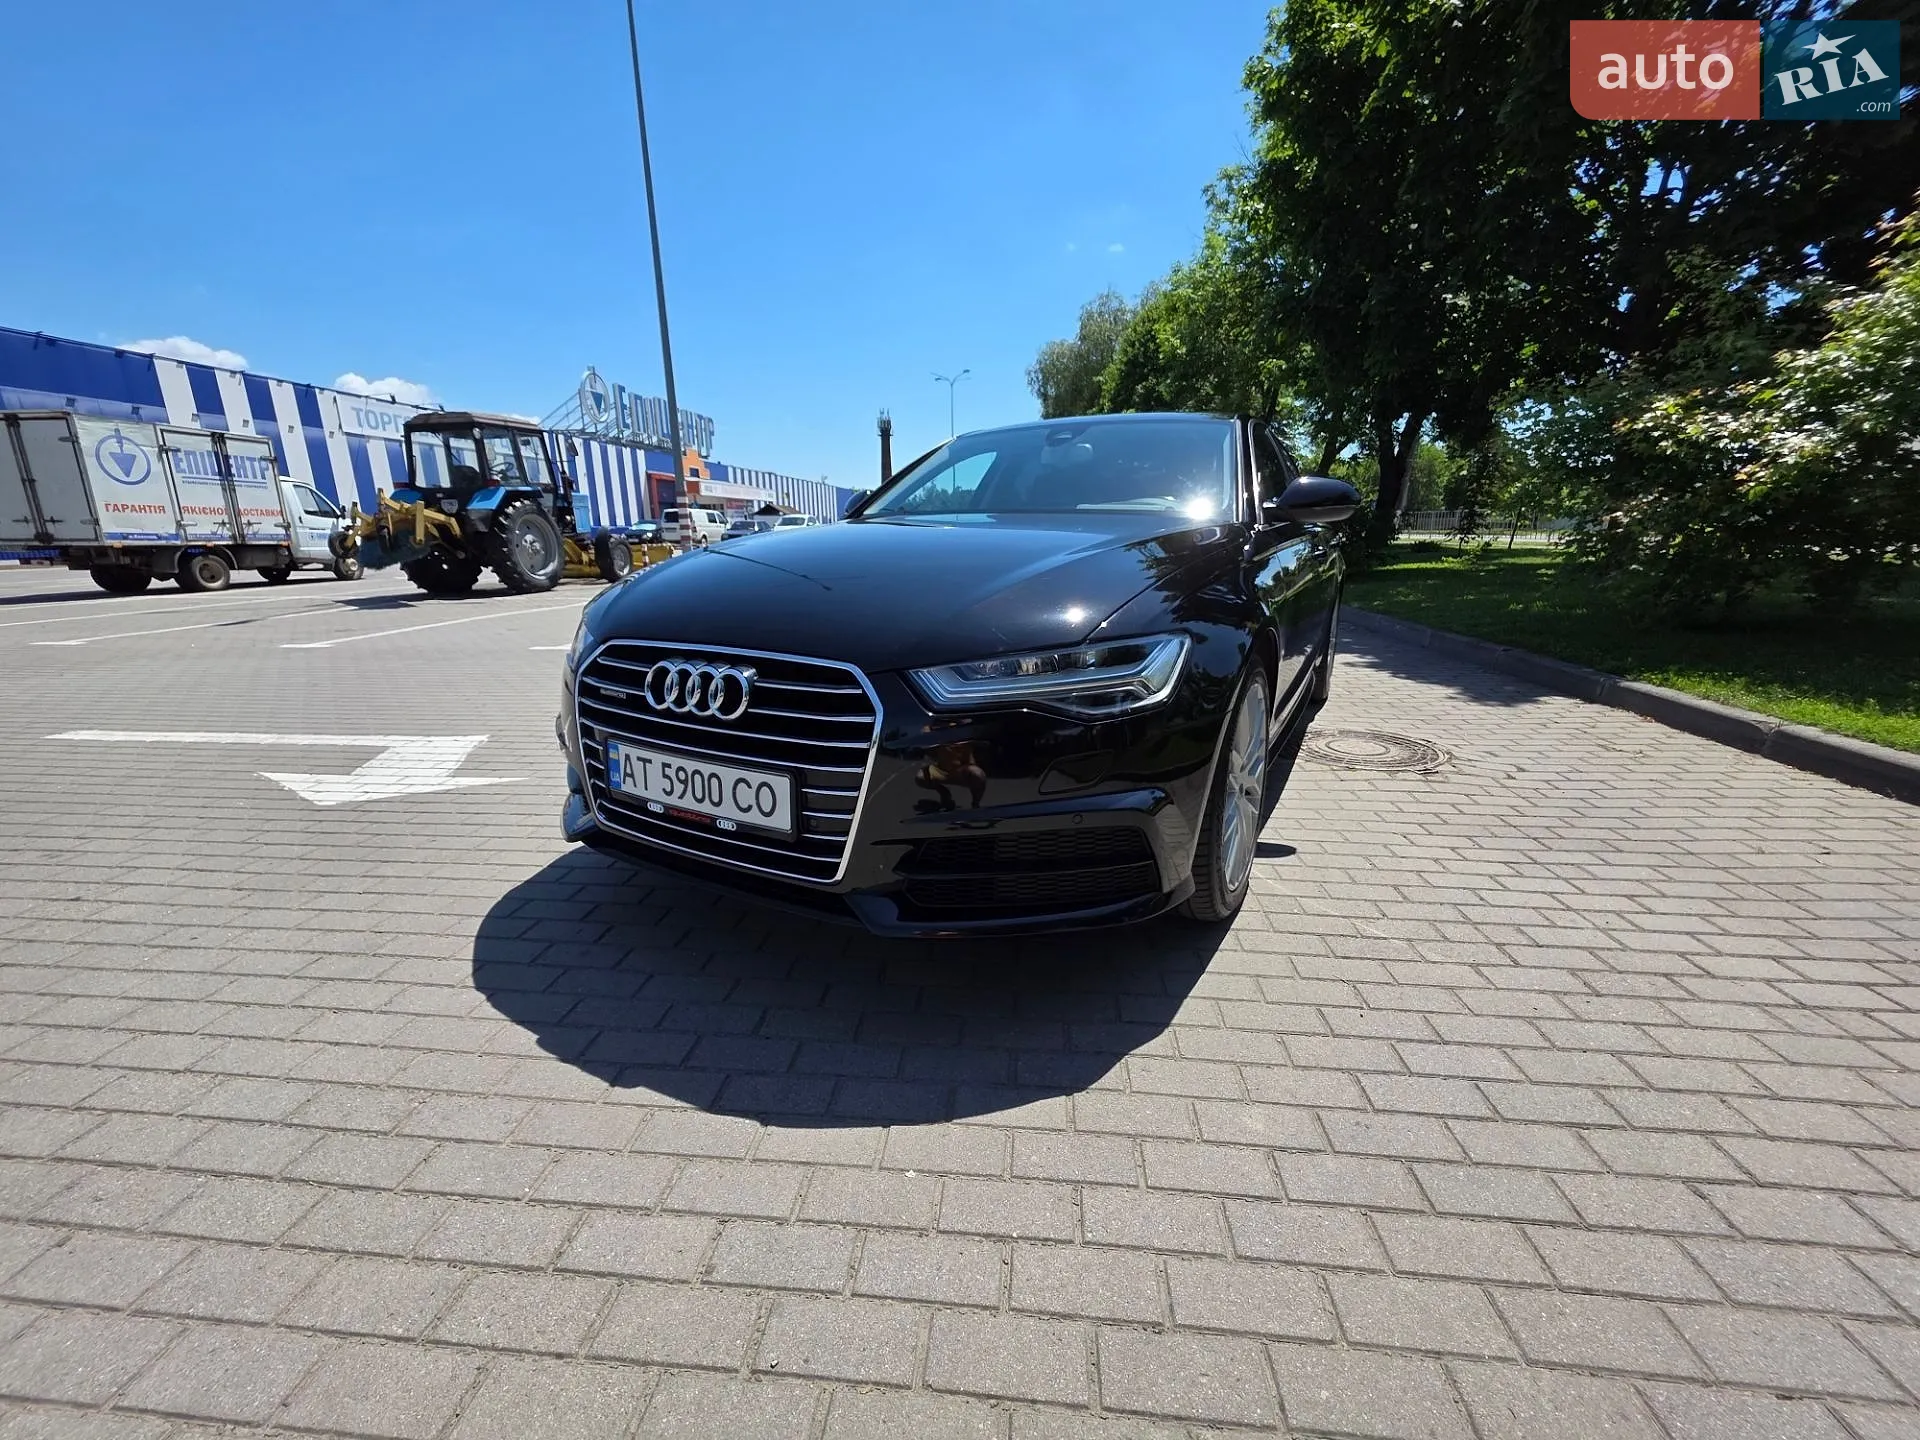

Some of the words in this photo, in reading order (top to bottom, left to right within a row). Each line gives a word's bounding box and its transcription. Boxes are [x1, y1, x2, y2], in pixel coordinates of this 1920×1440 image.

[612, 383, 715, 457] ЕПІЦНТР
[104, 503, 166, 514] ГАРАНТІЯ
[622, 753, 652, 791] AT
[662, 762, 723, 808] 5900
[732, 777, 777, 818] CO
